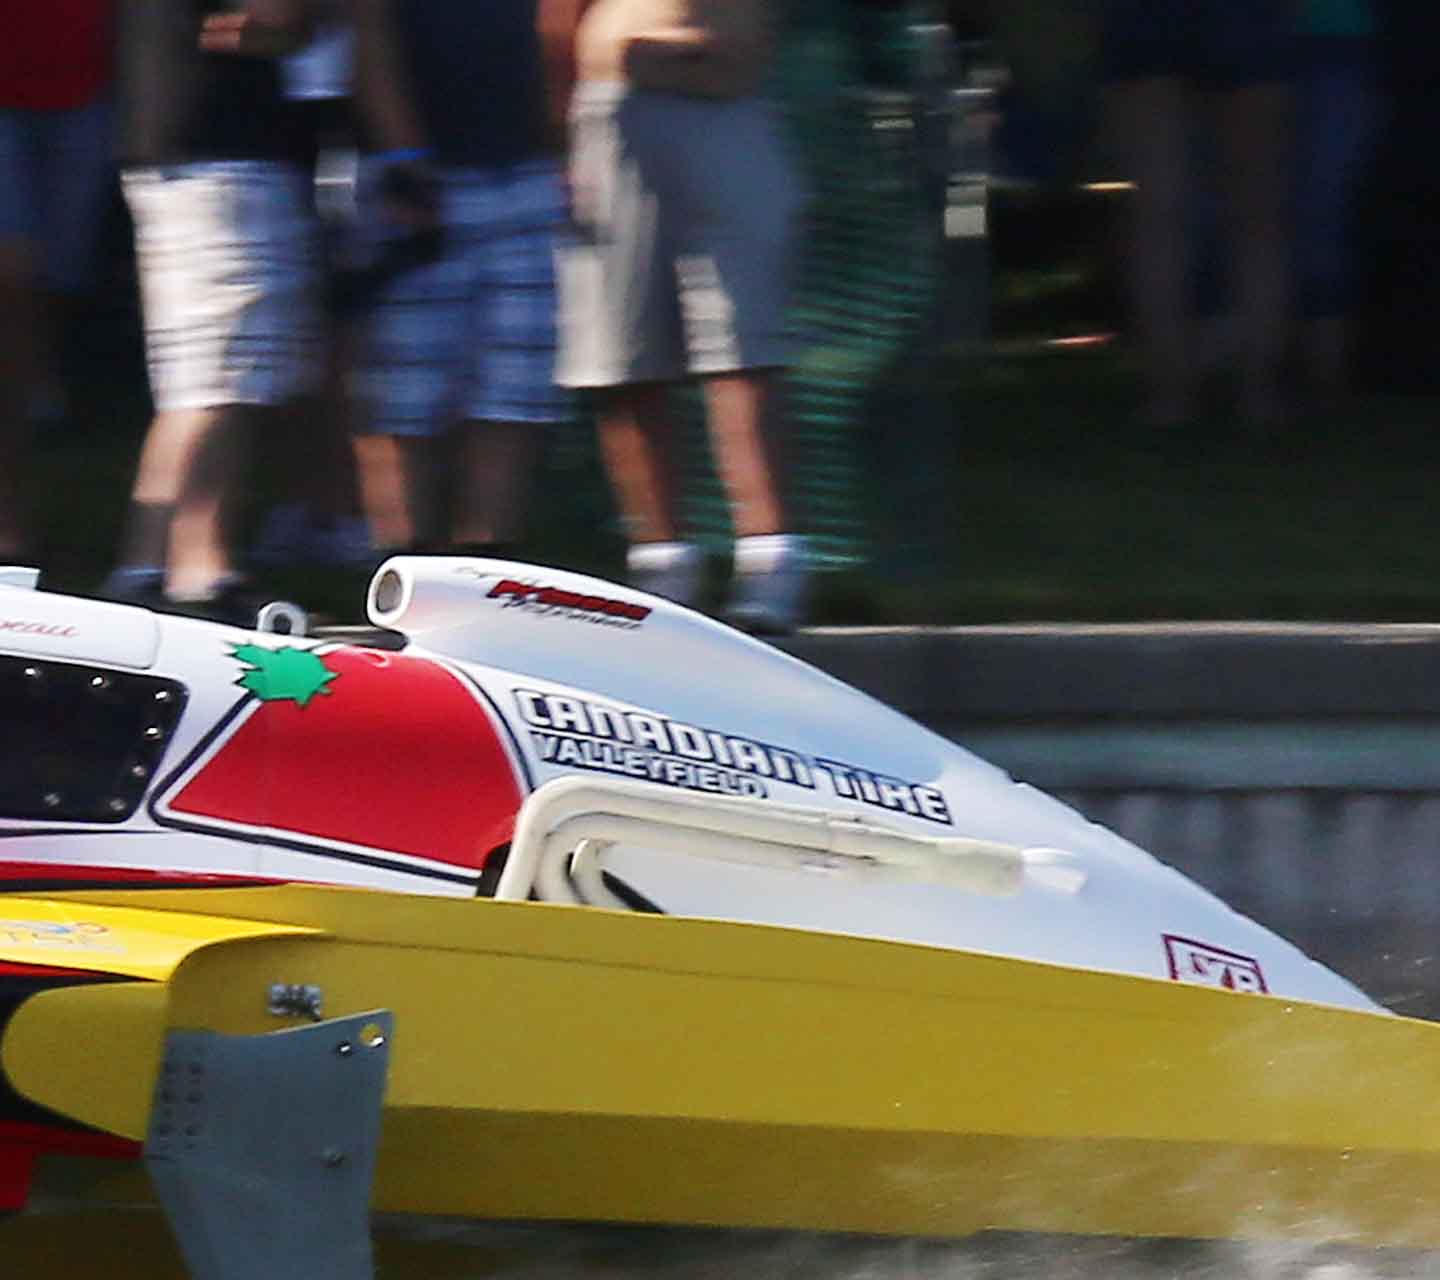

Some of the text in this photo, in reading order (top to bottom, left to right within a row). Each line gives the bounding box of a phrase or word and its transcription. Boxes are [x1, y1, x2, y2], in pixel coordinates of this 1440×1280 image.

[514, 689, 953, 824] CANADIAN TIRE
[531, 732, 768, 798] VALLEYFIELD
